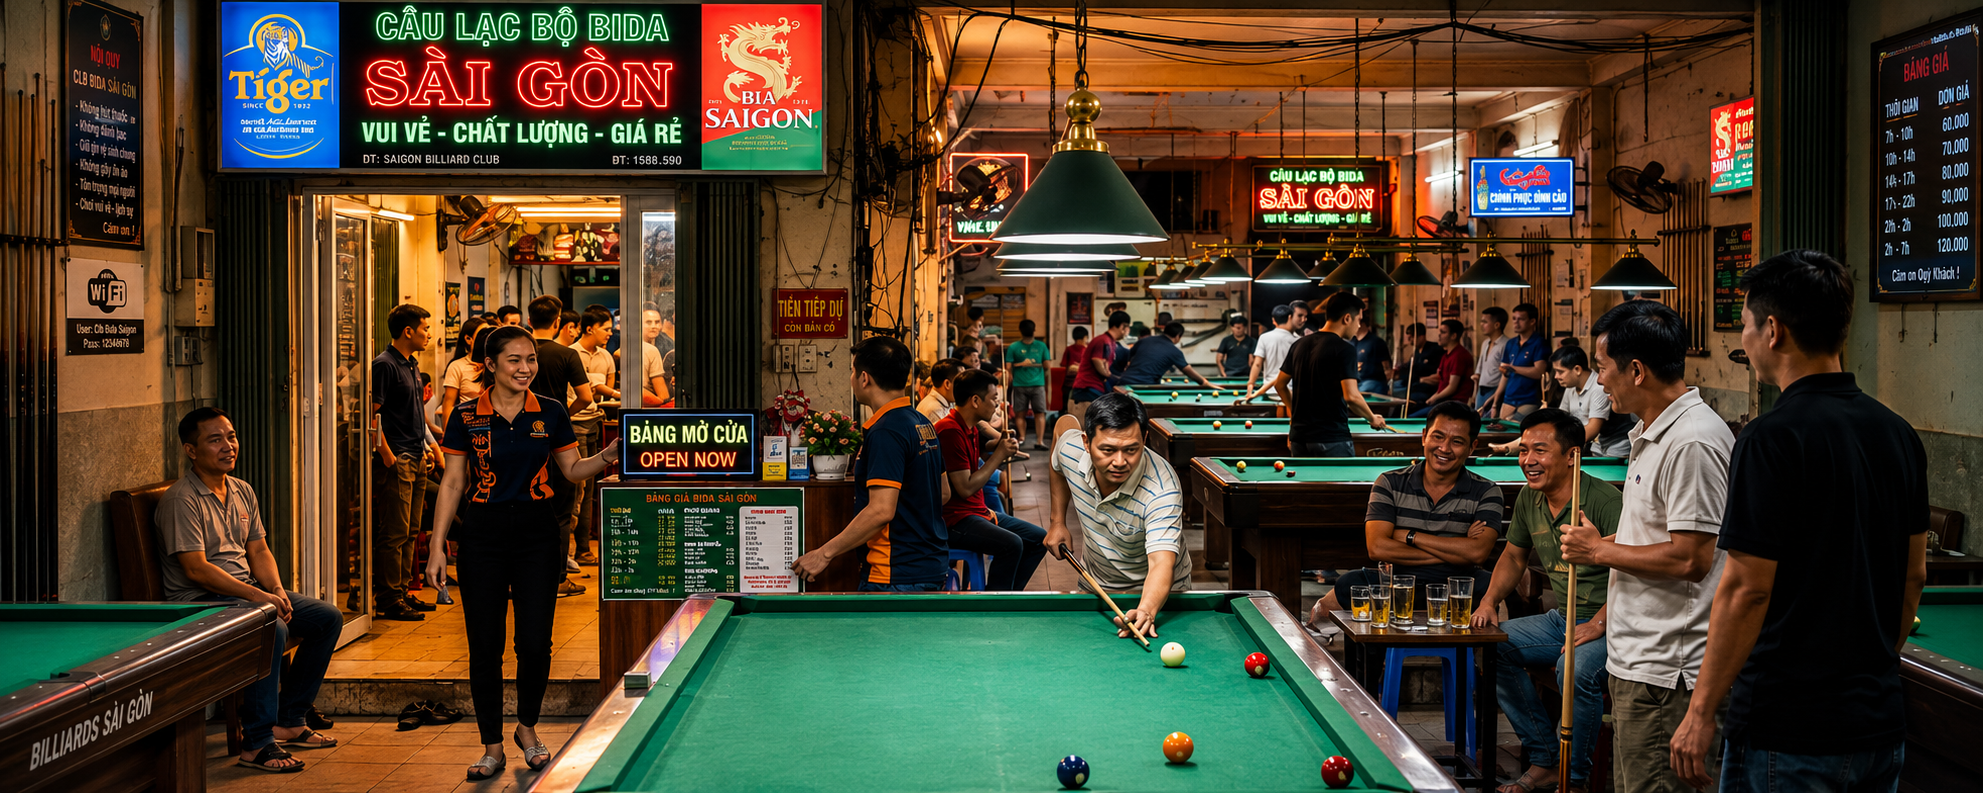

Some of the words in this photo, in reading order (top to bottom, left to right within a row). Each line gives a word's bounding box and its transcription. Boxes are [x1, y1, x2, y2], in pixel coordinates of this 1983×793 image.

[375, 5, 444, 41] CÂU
[455, 12, 521, 47] LẠC
[531, 6, 578, 47] BỘ
[588, 13, 669, 42] BIDA
[1932, 45, 1949, 74] GIÁ
[73, 69, 88, 86] CLB
[89, 73, 107, 91] BIDA
[366, 46, 491, 107] SÀI
[517, 47, 673, 108] GÒN
[228, 67, 330, 114] Tiger
[742, 91, 776, 105] BIA
[1901, 96, 1919, 114] GIAN
[705, 108, 813, 129] SAIGON
[1942, 112, 1969, 132] 60.000
[361, 121, 397, 143] VUI
[404, 115, 431, 143] VẺ
[453, 114, 510, 144] CHẤT
[517, 120, 589, 148] LƯỢNG
[611, 117, 648, 144] GIÁ
[654, 116, 682, 144] RẺ
[1885, 129, 1894, 144] 7h
[1901, 125, 1914, 141] 10h
[383, 154, 422, 164] SAIGON
[425, 154, 470, 164] BILLIARD
[473, 154, 500, 164] CLUB
[633, 155, 682, 165] 1588.590
[1885, 151, 1897, 166] 10h
[1903, 147, 1916, 163] 14h
[1295, 170, 1317, 185] LẠC
[1337, 170, 1364, 183] BIDA
[1903, 170, 1916, 186] 17h
[1259, 183, 1308, 209] SÀI
[1314, 183, 1375, 209] GÒN
[1937, 211, 1969, 229] 100.000
[1901, 241, 1910, 255] 7h
[1937, 236, 1969, 253] 120.000
[89, 283, 124, 301] WiFi
[76, 323, 93, 334] User:
[682, 419, 709, 443] MỞ
[714, 419, 749, 443] CỬA
[640, 451, 689, 468] OPEN
[694, 451, 737, 468] NOW
[693, 494, 715, 503] BIDA
[29, 715, 100, 771] BILLIARDS
[102, 700, 124, 736] SÀI
[126, 688, 153, 724] GÒN
